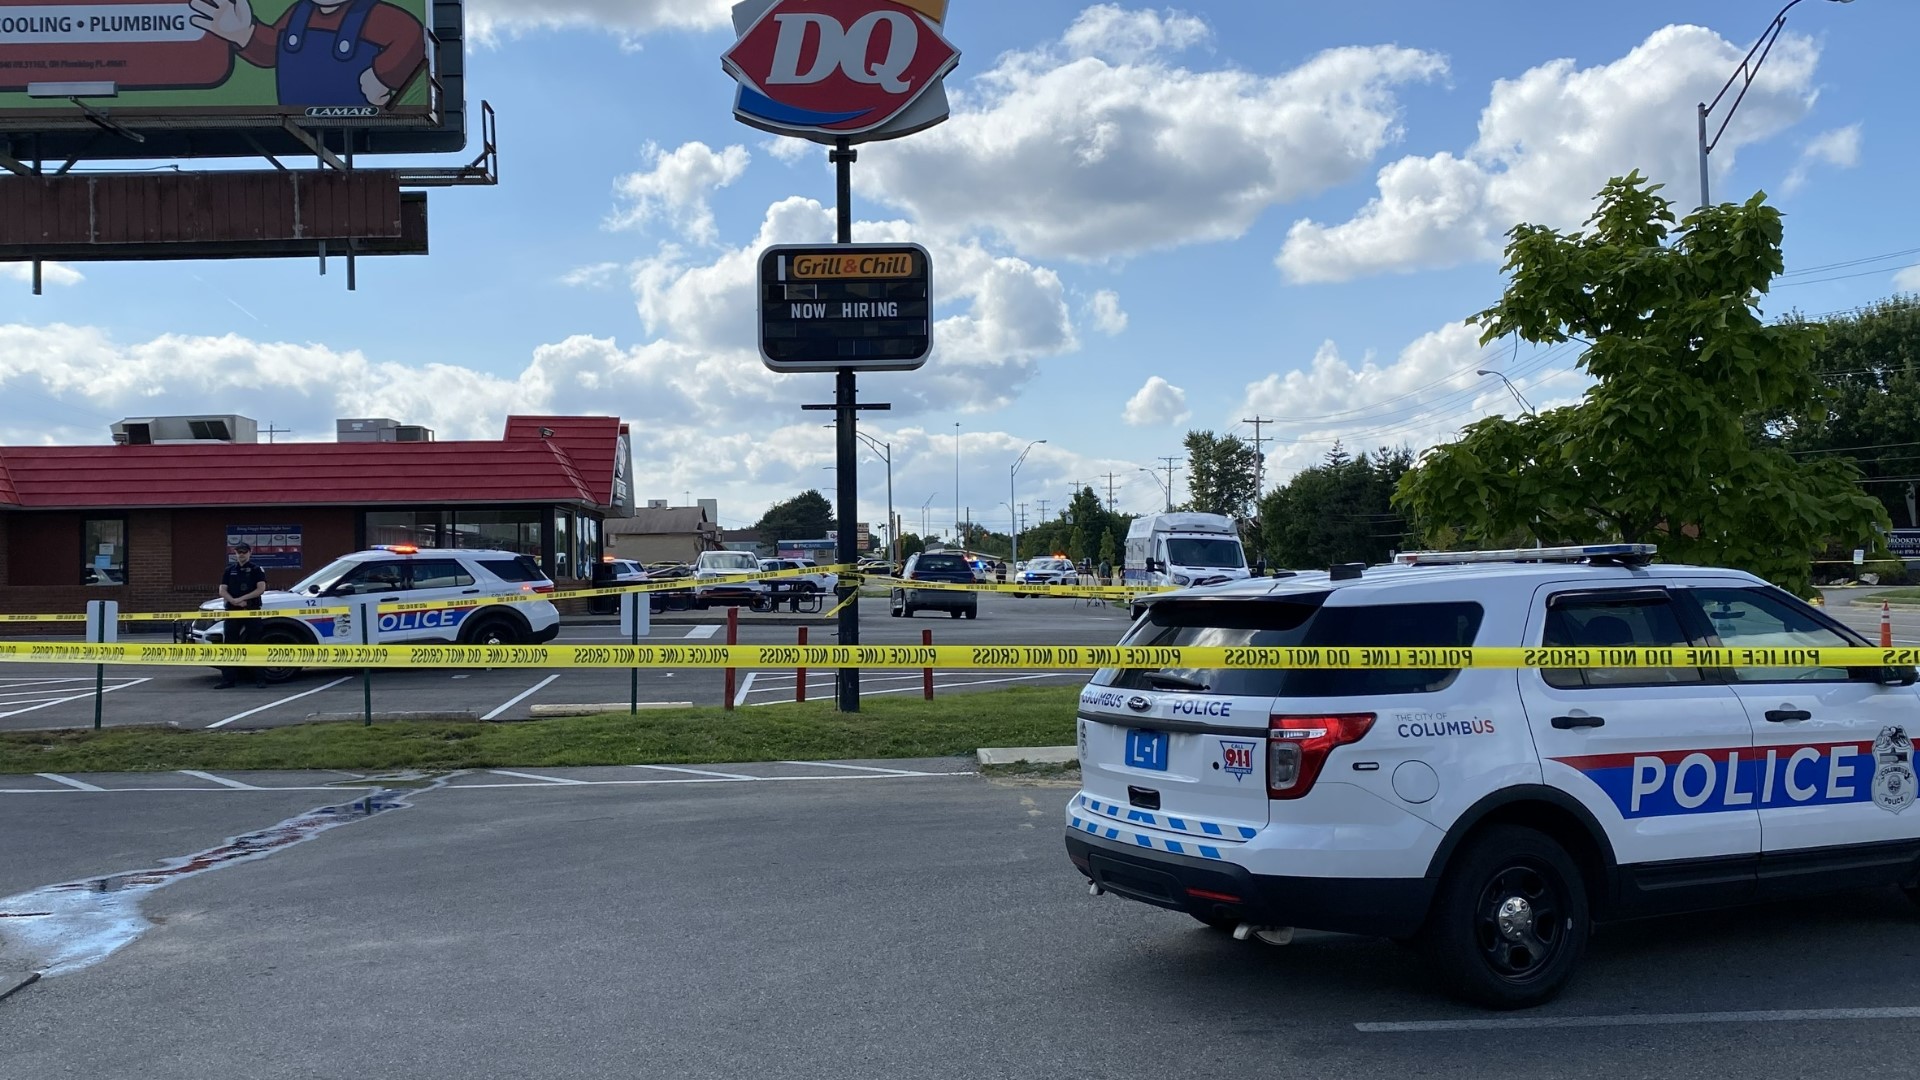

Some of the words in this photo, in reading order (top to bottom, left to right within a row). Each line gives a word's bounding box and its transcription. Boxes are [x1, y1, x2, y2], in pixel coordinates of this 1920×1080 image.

[0, 16, 71, 33] OOLING
[90, 15, 185, 31] PLUMBING
[765, 10, 919, 94] DQ
[311, 108, 372, 116] LAMAR
[791, 303, 826, 319] NOW
[842, 302, 898, 318] HIRING
[378, 609, 456, 631] OLICE
[1081, 691, 1124, 708] COLUMBUS
[1173, 701, 1232, 717] POLICE
[1397, 719, 1495, 738] COLUMBUS
[1133, 735, 1158, 764] L-1
[1631, 745, 1859, 812] POLICE
[1881, 766, 1910, 777] COLUMBUS
[1884, 796, 1904, 805] POLICE
